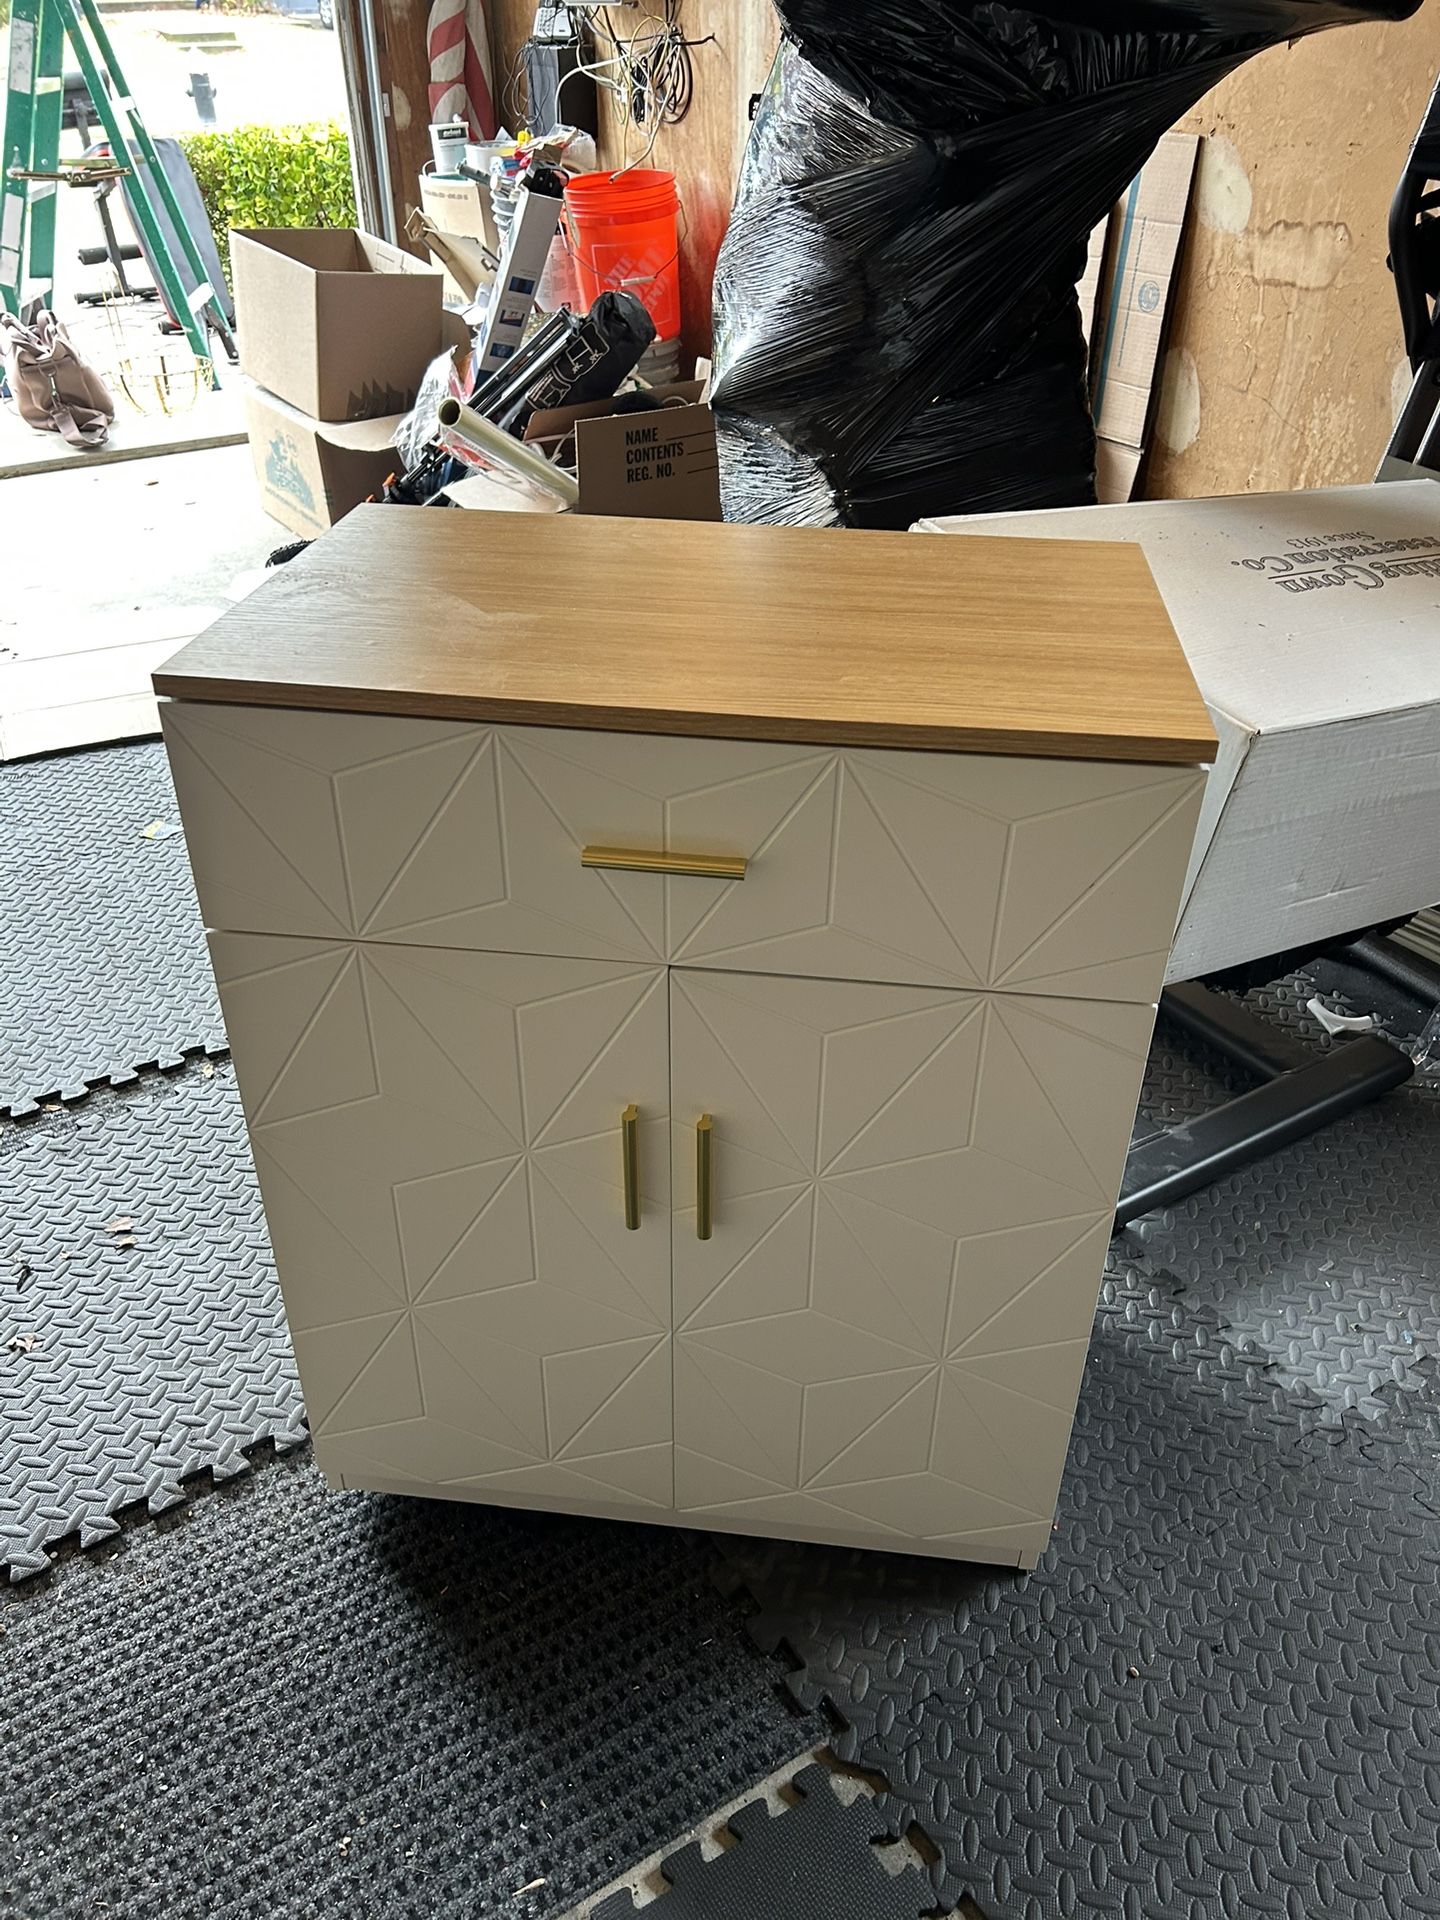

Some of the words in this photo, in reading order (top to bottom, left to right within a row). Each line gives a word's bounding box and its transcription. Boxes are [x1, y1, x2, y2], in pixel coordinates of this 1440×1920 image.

[625, 427, 659, 446] NAME
[626, 442, 684, 465] CONTENTS
[627, 466, 653, 483] REG.
[656, 462, 676, 479] NO.
[1286, 537, 1328, 549] 1913
[1323, 531, 1375, 541] Since
[1231, 555, 1294, 573] Co.
[1369, 558, 1440, 578] ding
[1275, 564, 1384, 593] Gown
